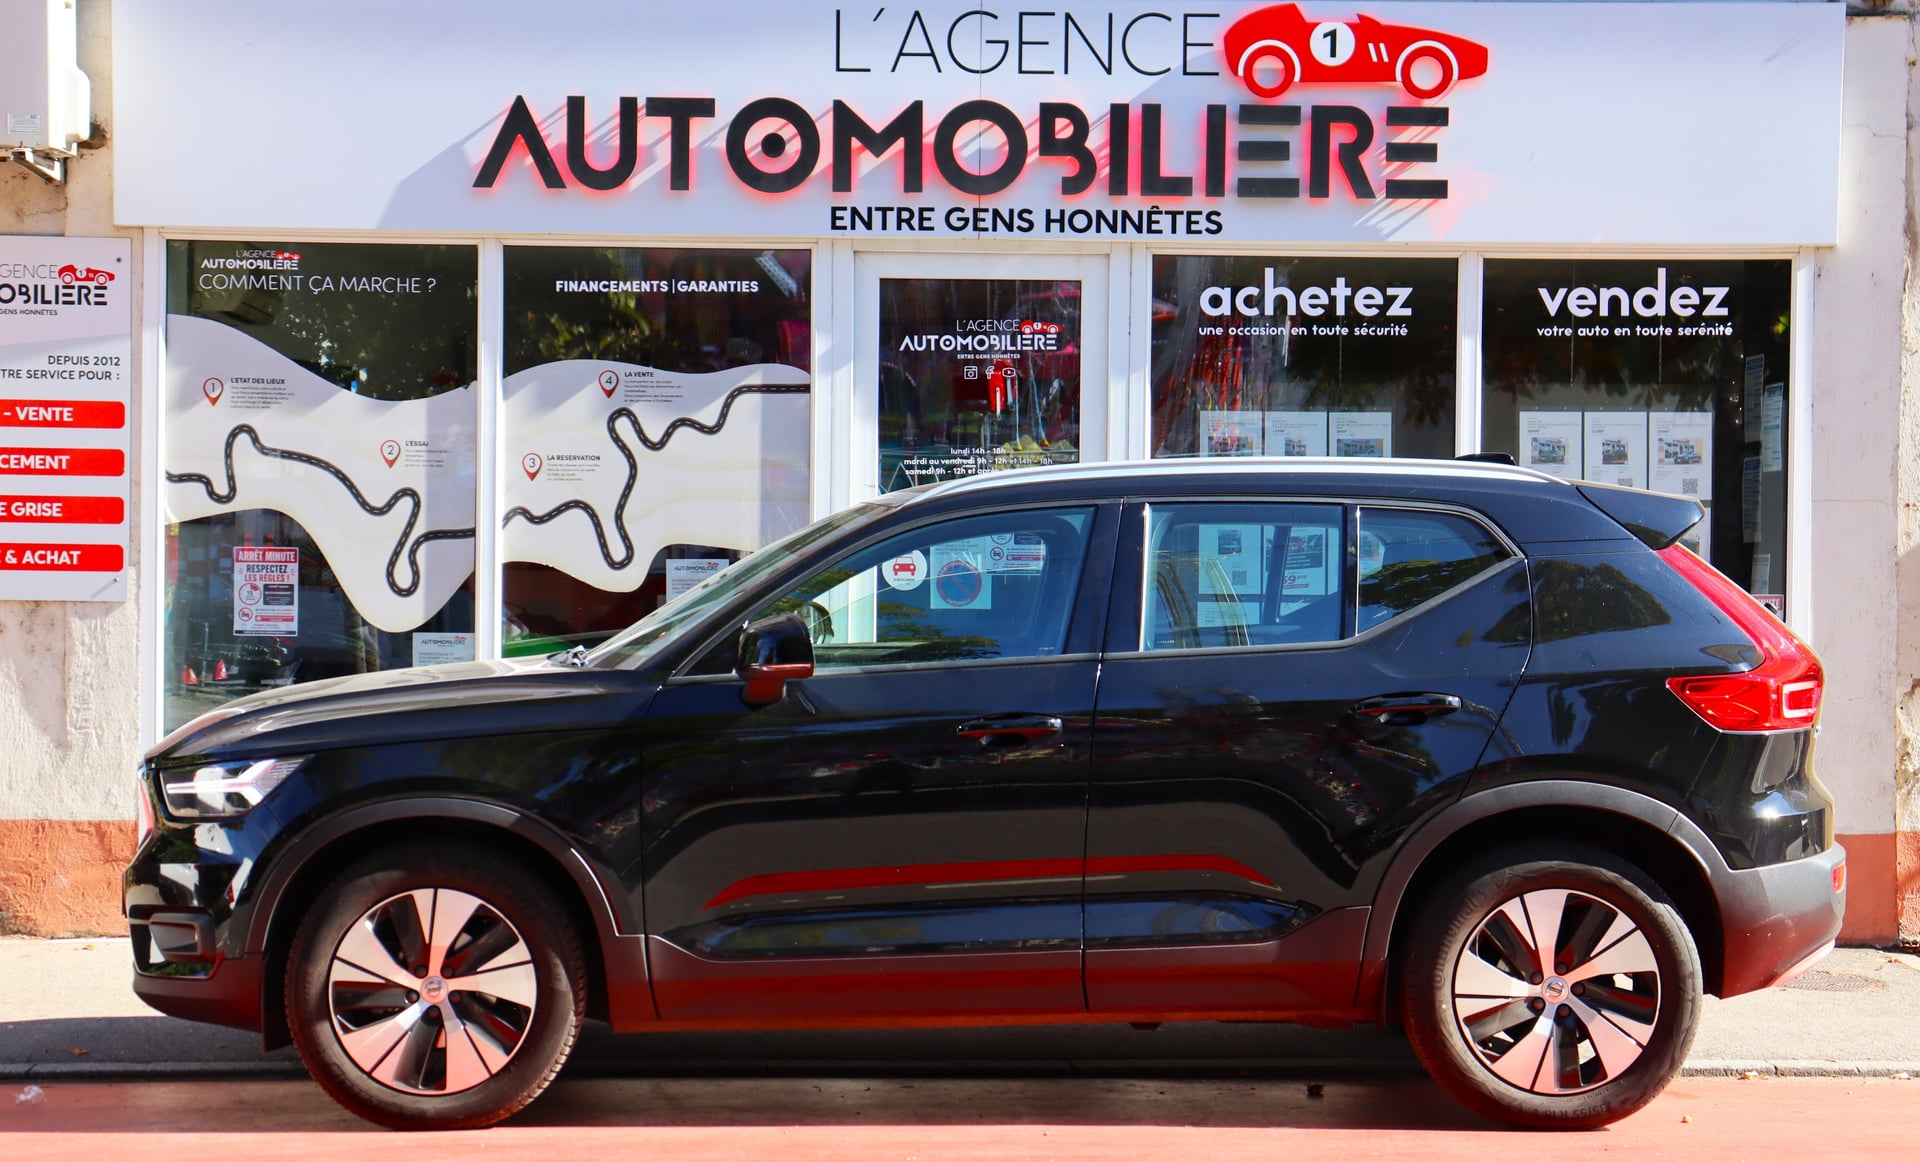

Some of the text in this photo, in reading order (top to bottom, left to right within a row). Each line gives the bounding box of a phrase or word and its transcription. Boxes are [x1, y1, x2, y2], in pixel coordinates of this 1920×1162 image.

[835, 8, 1220, 76] L'AGENCE
[1323, 28, 1338, 58] 1
[831, 205, 1223, 235] ENTRE GENS HONNÊTES
[236, 250, 276, 259] L'AGENCE
[199, 273, 303, 290] COMMENT
[308, 276, 334, 295] ÇA
[340, 276, 421, 293] MARCHE
[555, 280, 759, 293] FINANCEMENTS GARANTIES
[1199, 267, 1413, 317] achetez
[1537, 267, 1730, 318] vendez
[956, 319, 1020, 332] L'AGENCE
[1199, 322, 1408, 336] une occasion en toute sécurité
[1536, 326, 1573, 337] votre
[1577, 326, 1609, 337] auto
[1614, 327, 1631, 337] en
[1635, 326, 1673, 337] toute
[48, 355, 121, 366] DEPUIS 2012
[26, 369, 75, 380] SERVICE
[79, 371, 112, 381] POUR
[604, 376, 613, 386] 4
[16, 406, 74, 421] VENTE
[386, 444, 395, 456] 2
[950, 447, 971, 455] lundi
[972, 447, 986, 455] 14h
[992, 447, 1006, 455] 18h
[0, 455, 70, 470] CEMENT
[528, 458, 536, 469] 3
[903, 457, 928, 465] mardi
[940, 456, 976, 465] vendredi
[977, 457, 987, 465] 9h
[995, 457, 1008, 465] 12h
[905, 466, 934, 475] samedi
[935, 466, 946, 475] 9h
[953, 466, 966, 475] 12h
[967, 467, 976, 475] et
[11, 502, 63, 517] GRISE
[22, 550, 81, 565] ACHAT
[238, 550, 296, 562] ARRÊT MINUTE
[246, 564, 288, 574] RESPECTEZ
[245, 574, 257, 582] LES
